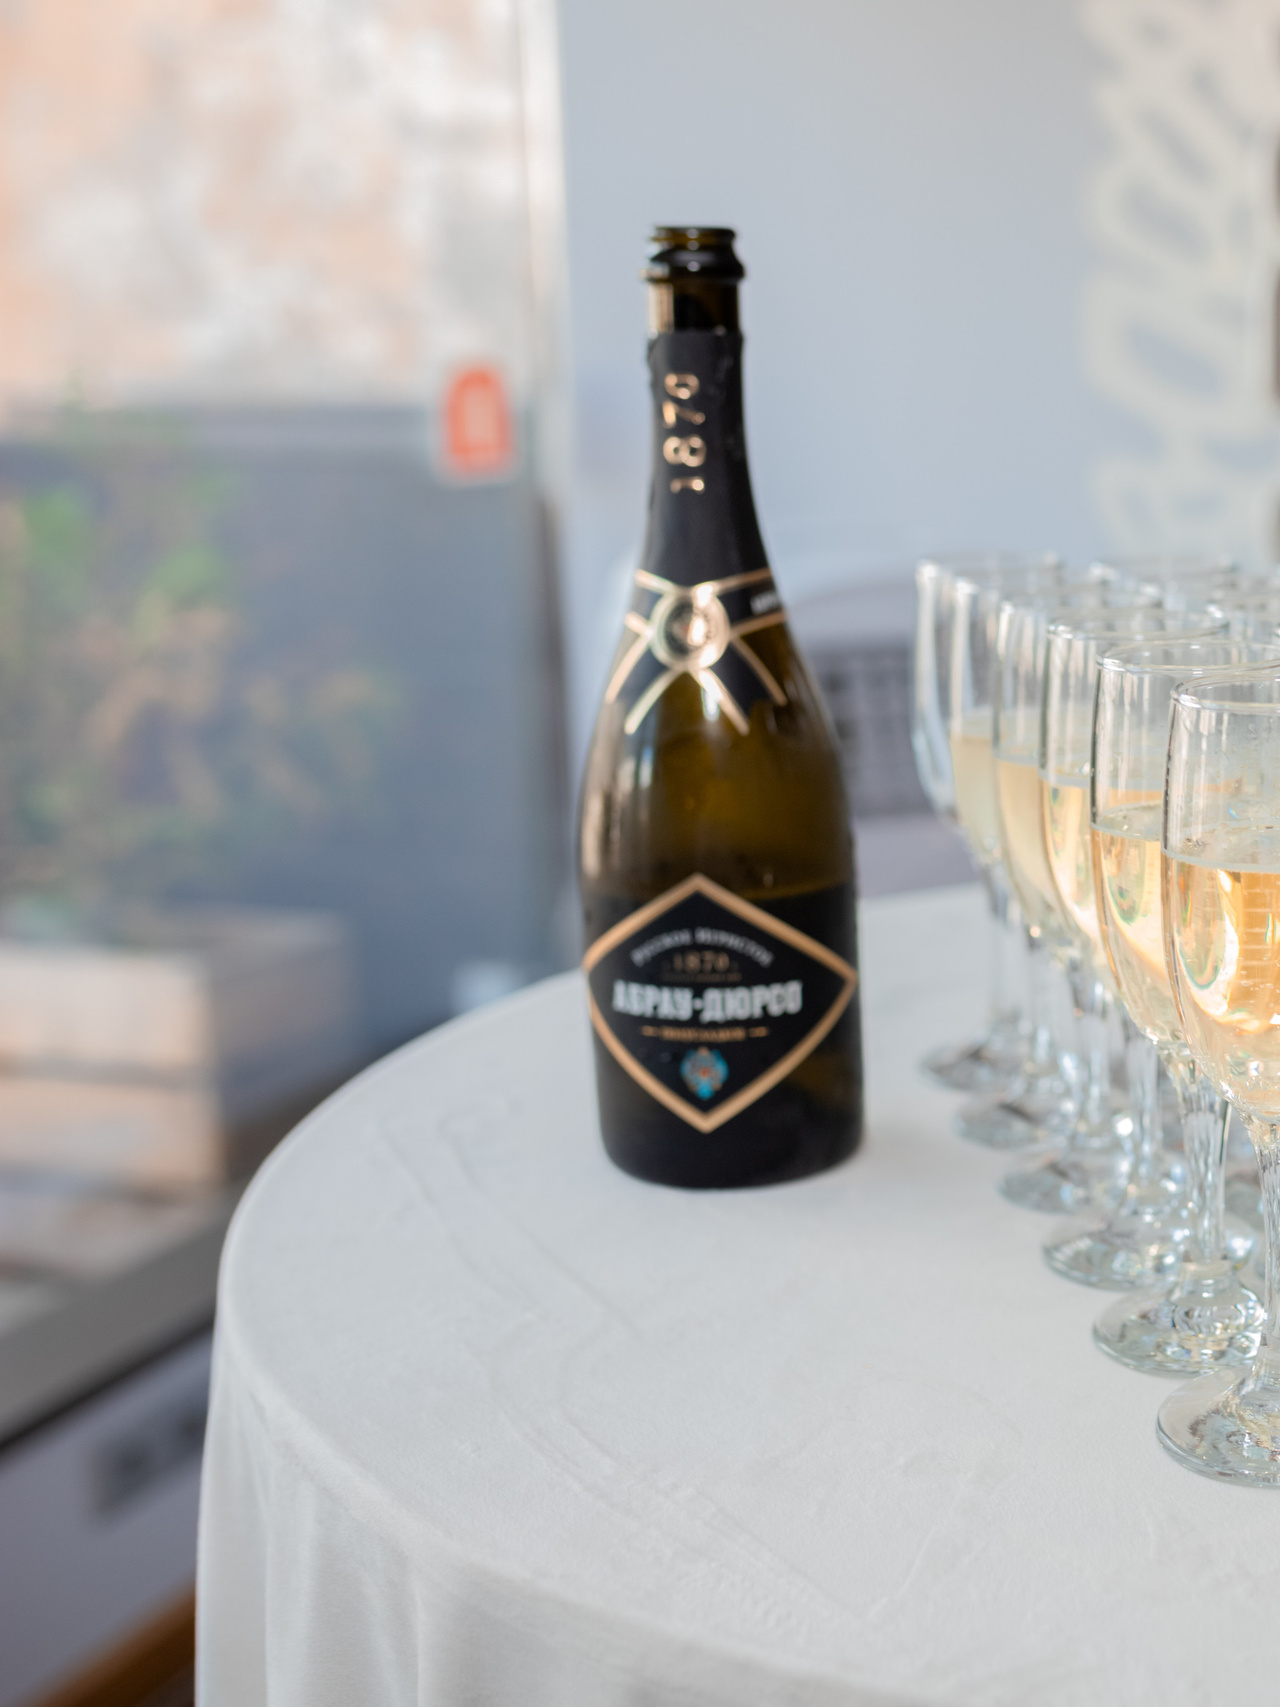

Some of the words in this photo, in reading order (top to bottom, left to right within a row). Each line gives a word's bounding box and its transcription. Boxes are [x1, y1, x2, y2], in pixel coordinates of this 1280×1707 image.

[662, 372, 706, 494] 1870
[673, 951, 730, 973] 1870
[612, 979, 803, 1024] АБРАУ-ДЮРСО
